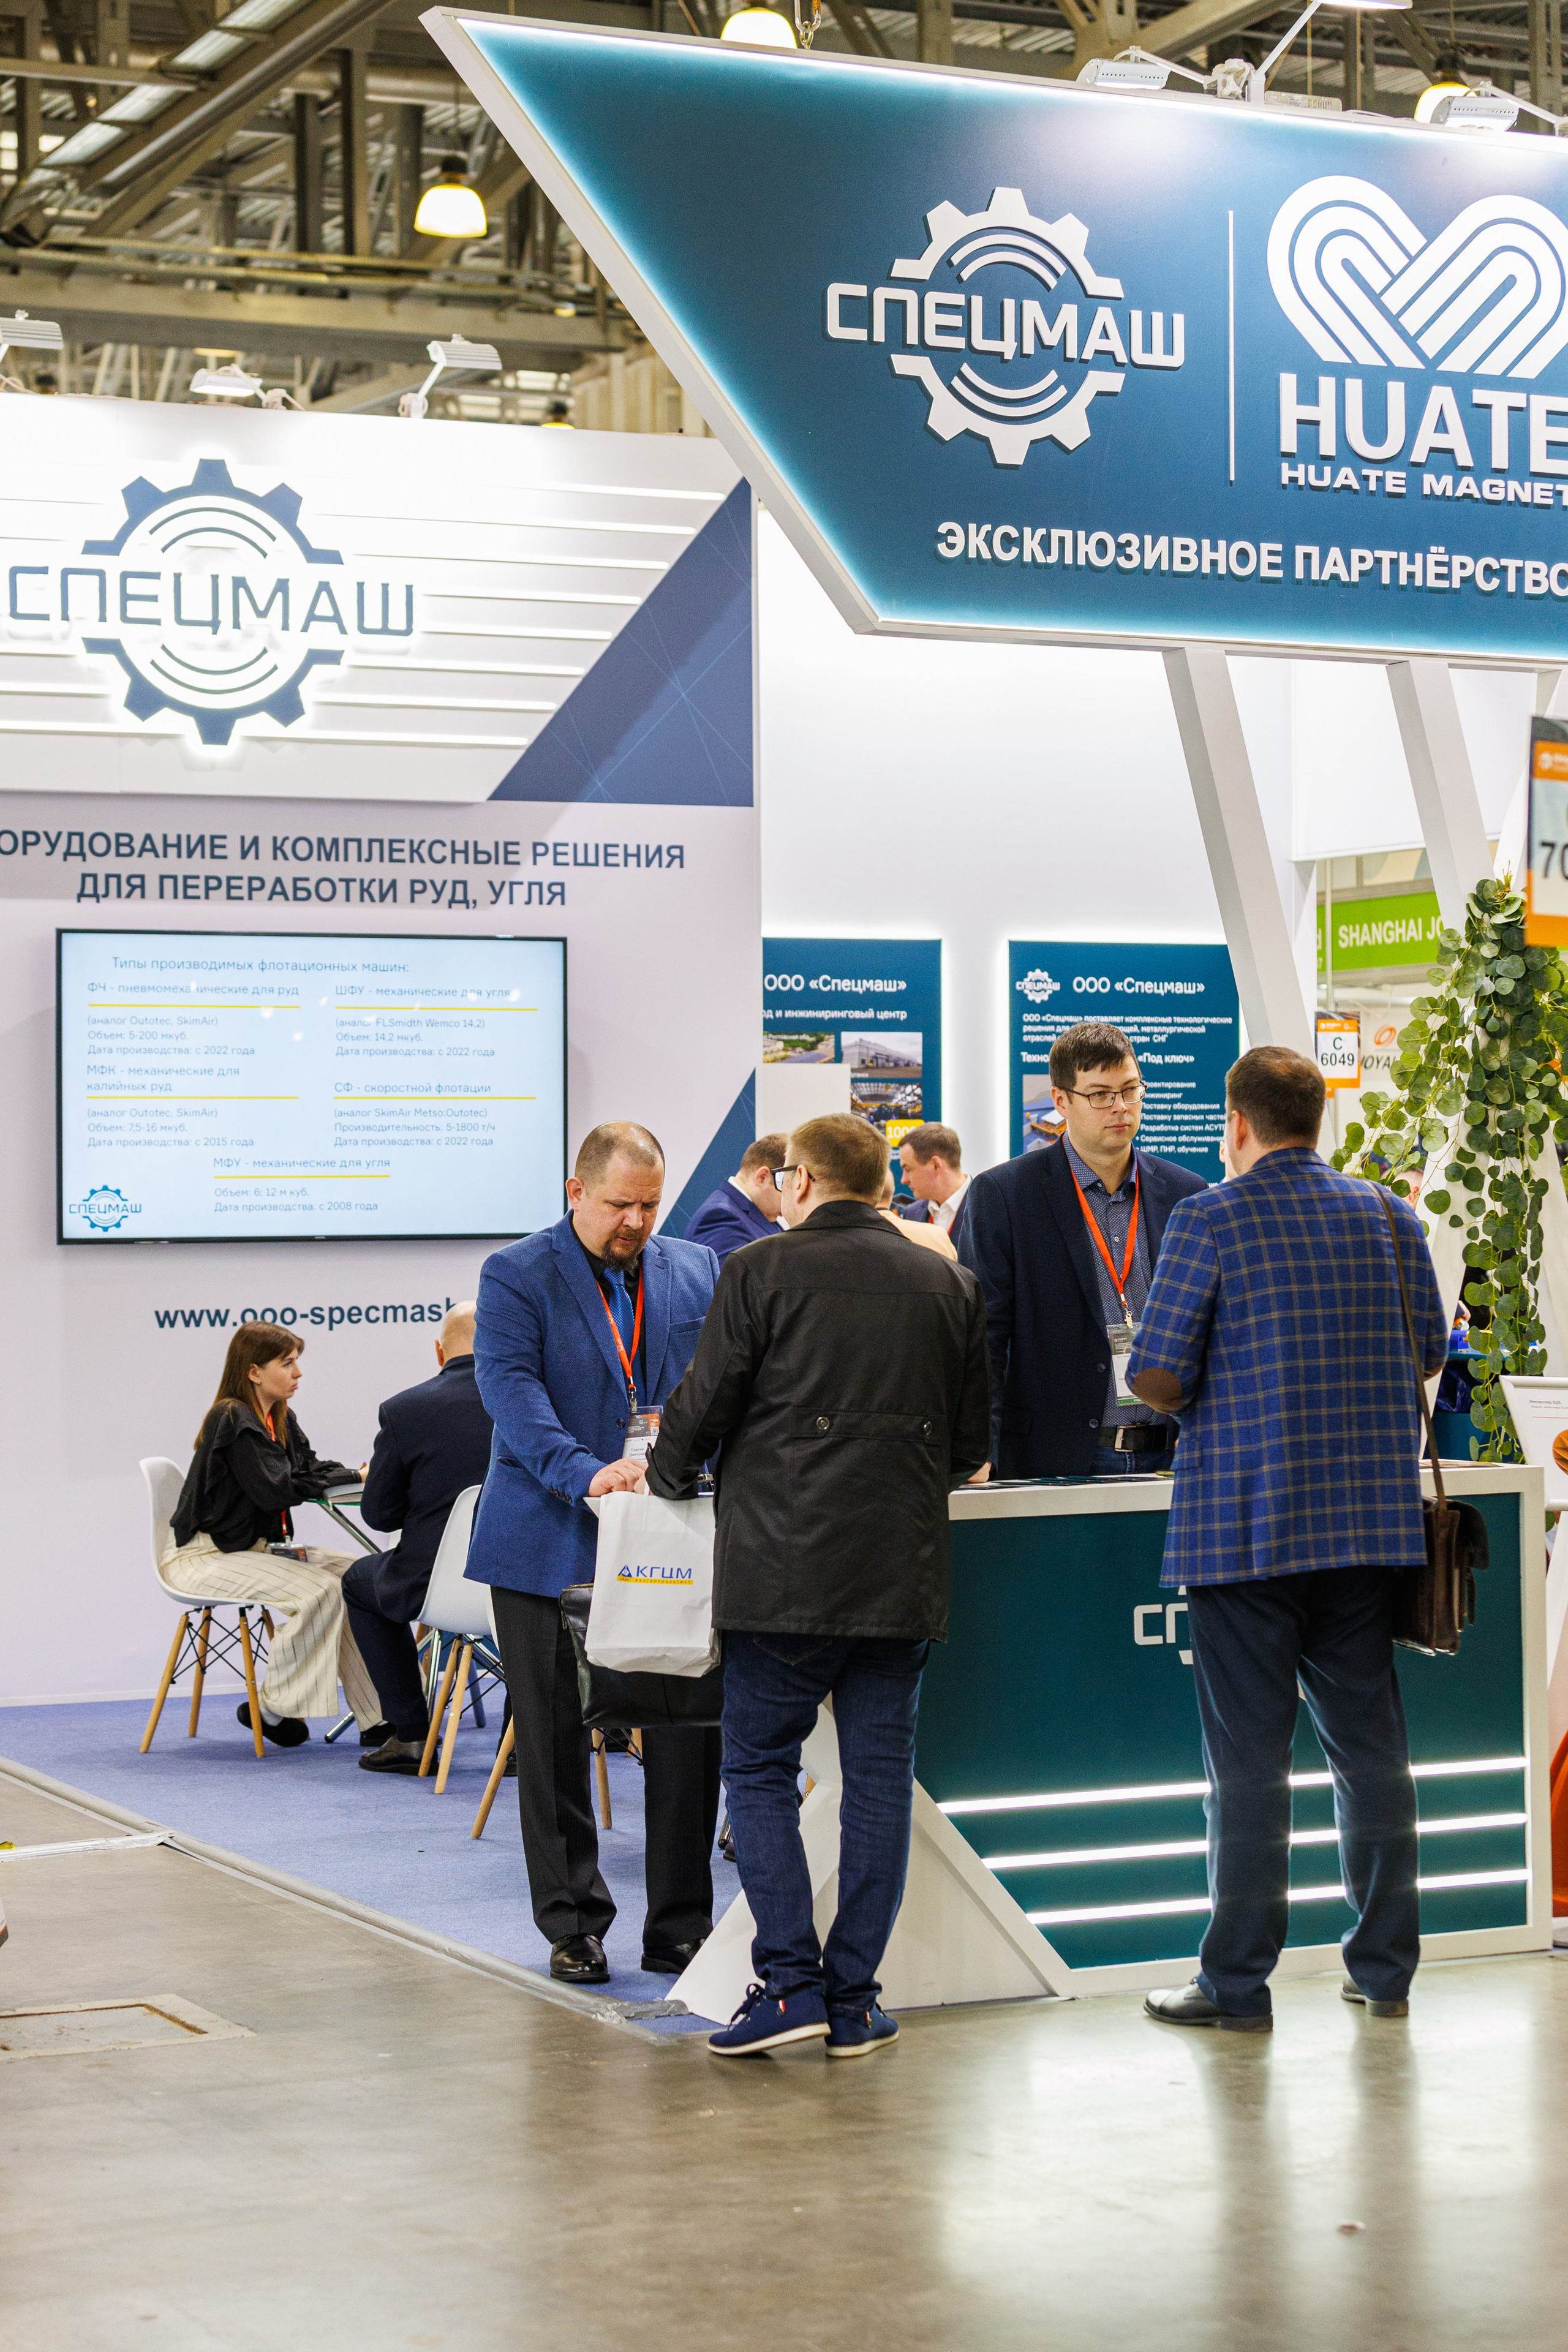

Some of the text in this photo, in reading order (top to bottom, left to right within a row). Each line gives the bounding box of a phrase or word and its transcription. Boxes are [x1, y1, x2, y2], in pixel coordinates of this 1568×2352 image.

[827, 282, 1185, 368] СПЕЦМАШ
[1280, 372, 1568, 475] HUATE
[1281, 462, 1407, 494] HUATE
[937, 521, 1568, 597] ЭКСКЛЮЗИВНОЕ ПАРТНЁРСТВО
[9, 565, 415, 637] СПЕЦМАШ
[239, 834, 260, 861] И
[272, 835, 522, 865] КОМПЛЕКСНЫЕ
[532, 841, 685, 869] РЕШЕНИЯ
[77, 872, 567, 910] ДЛЯ ПЕРЕРАБОТКИ РУД, УГЛЯ
[1338, 918, 1422, 949] SHANGHAI
[111, 956, 410, 973] Типы производимых флотационных машин:
[88, 982, 106, 992] ФЧ
[252, 986, 274, 996] для
[278, 987, 299, 997] руд
[764, 974, 907, 993] ООО «Спецмаш»
[1016, 980, 1061, 991] СПЕЦМАШ
[1072, 976, 1205, 997] ООО «Спецмаш»
[335, 985, 364, 995] ШФУ
[376, 987, 458, 997] механические
[486, 989, 510, 998] угля
[785, 1008, 875, 1020] инжиниринговый
[876, 1010, 908, 1020] центр
[1022, 1014, 1041, 1022] ООО
[1042, 1014, 1084, 1023] «Спецмаш»
[1173, 1016, 1233, 1025] технологические
[88, 1016, 218, 1027] (аналог Outotec, SkimAir)
[375, 1018, 423, 1028] FLSmidth
[425, 1019, 461, 1028] Wemco
[88, 1030, 126, 1040] Объем:
[129, 1031, 158, 1040] 5-200
[1140, 1025, 1206, 1035] металлургической
[336, 1033, 372, 1042] Объем:
[1023, 1033, 1169, 1044] отраслей стран СНГ
[88, 1045, 113, 1055] Дата
[116, 1046, 192, 1057] производства:
[204, 1046, 228, 1055] 2022
[231, 1047, 255, 1056] года
[336, 1046, 360, 1057] Дата
[363, 1047, 435, 1058] производства:
[447, 1047, 470, 1057] 2022
[472, 1049, 496, 1057] года
[1137, 1052, 1163, 1065] «Под
[1165, 1054, 1195, 1064] ключ»
[1321, 1053, 1355, 1066] 6049
[86, 1065, 116, 1076] МФК
[128, 1066, 214, 1076] механические
[217, 1068, 240, 1077] для
[86, 1082, 173, 1093] калийных руд
[334, 1082, 353, 1093] СФ
[364, 1083, 432, 1095] скоростной
[435, 1083, 491, 1095] флотации
[1173, 1102, 1220, 1111] оборудования
[87, 1108, 219, 1118] (аналог Outotec, SkimAir)
[334, 1109, 372, 1118] (аналог
[374, 1108, 412, 1117] SkimAir
[1141, 1113, 1172, 1121] Поставку
[88, 1123, 126, 1133] Объем:
[334, 1123, 444, 1133] Производительность:
[446, 1123, 480, 1132] 5-1800
[87, 1137, 113, 1148] Дата
[116, 1138, 192, 1148] производства:
[203, 1137, 228, 1147] 2015
[230, 1139, 254, 1148] года
[334, 1137, 359, 1147] Дата
[361, 1137, 434, 1148] производства:
[445, 1137, 469, 1146] 2022
[471, 1138, 494, 1147] года
[213, 1158, 241, 1168] МФУ
[252, 1158, 336, 1168] механические
[339, 1159, 361, 1169] для
[364, 1159, 391, 1170] угля
[214, 1188, 252, 1197] Объем:
[266, 1188, 277, 1197] 12
[69, 1204, 142, 1214] СПЕЦМАШ
[214, 1202, 239, 1213] Дата
[241, 1203, 315, 1213] производства:
[327, 1202, 352, 1211] 2008
[355, 1202, 378, 1212] года
[636, 1566, 692, 1579] КГЦМ
